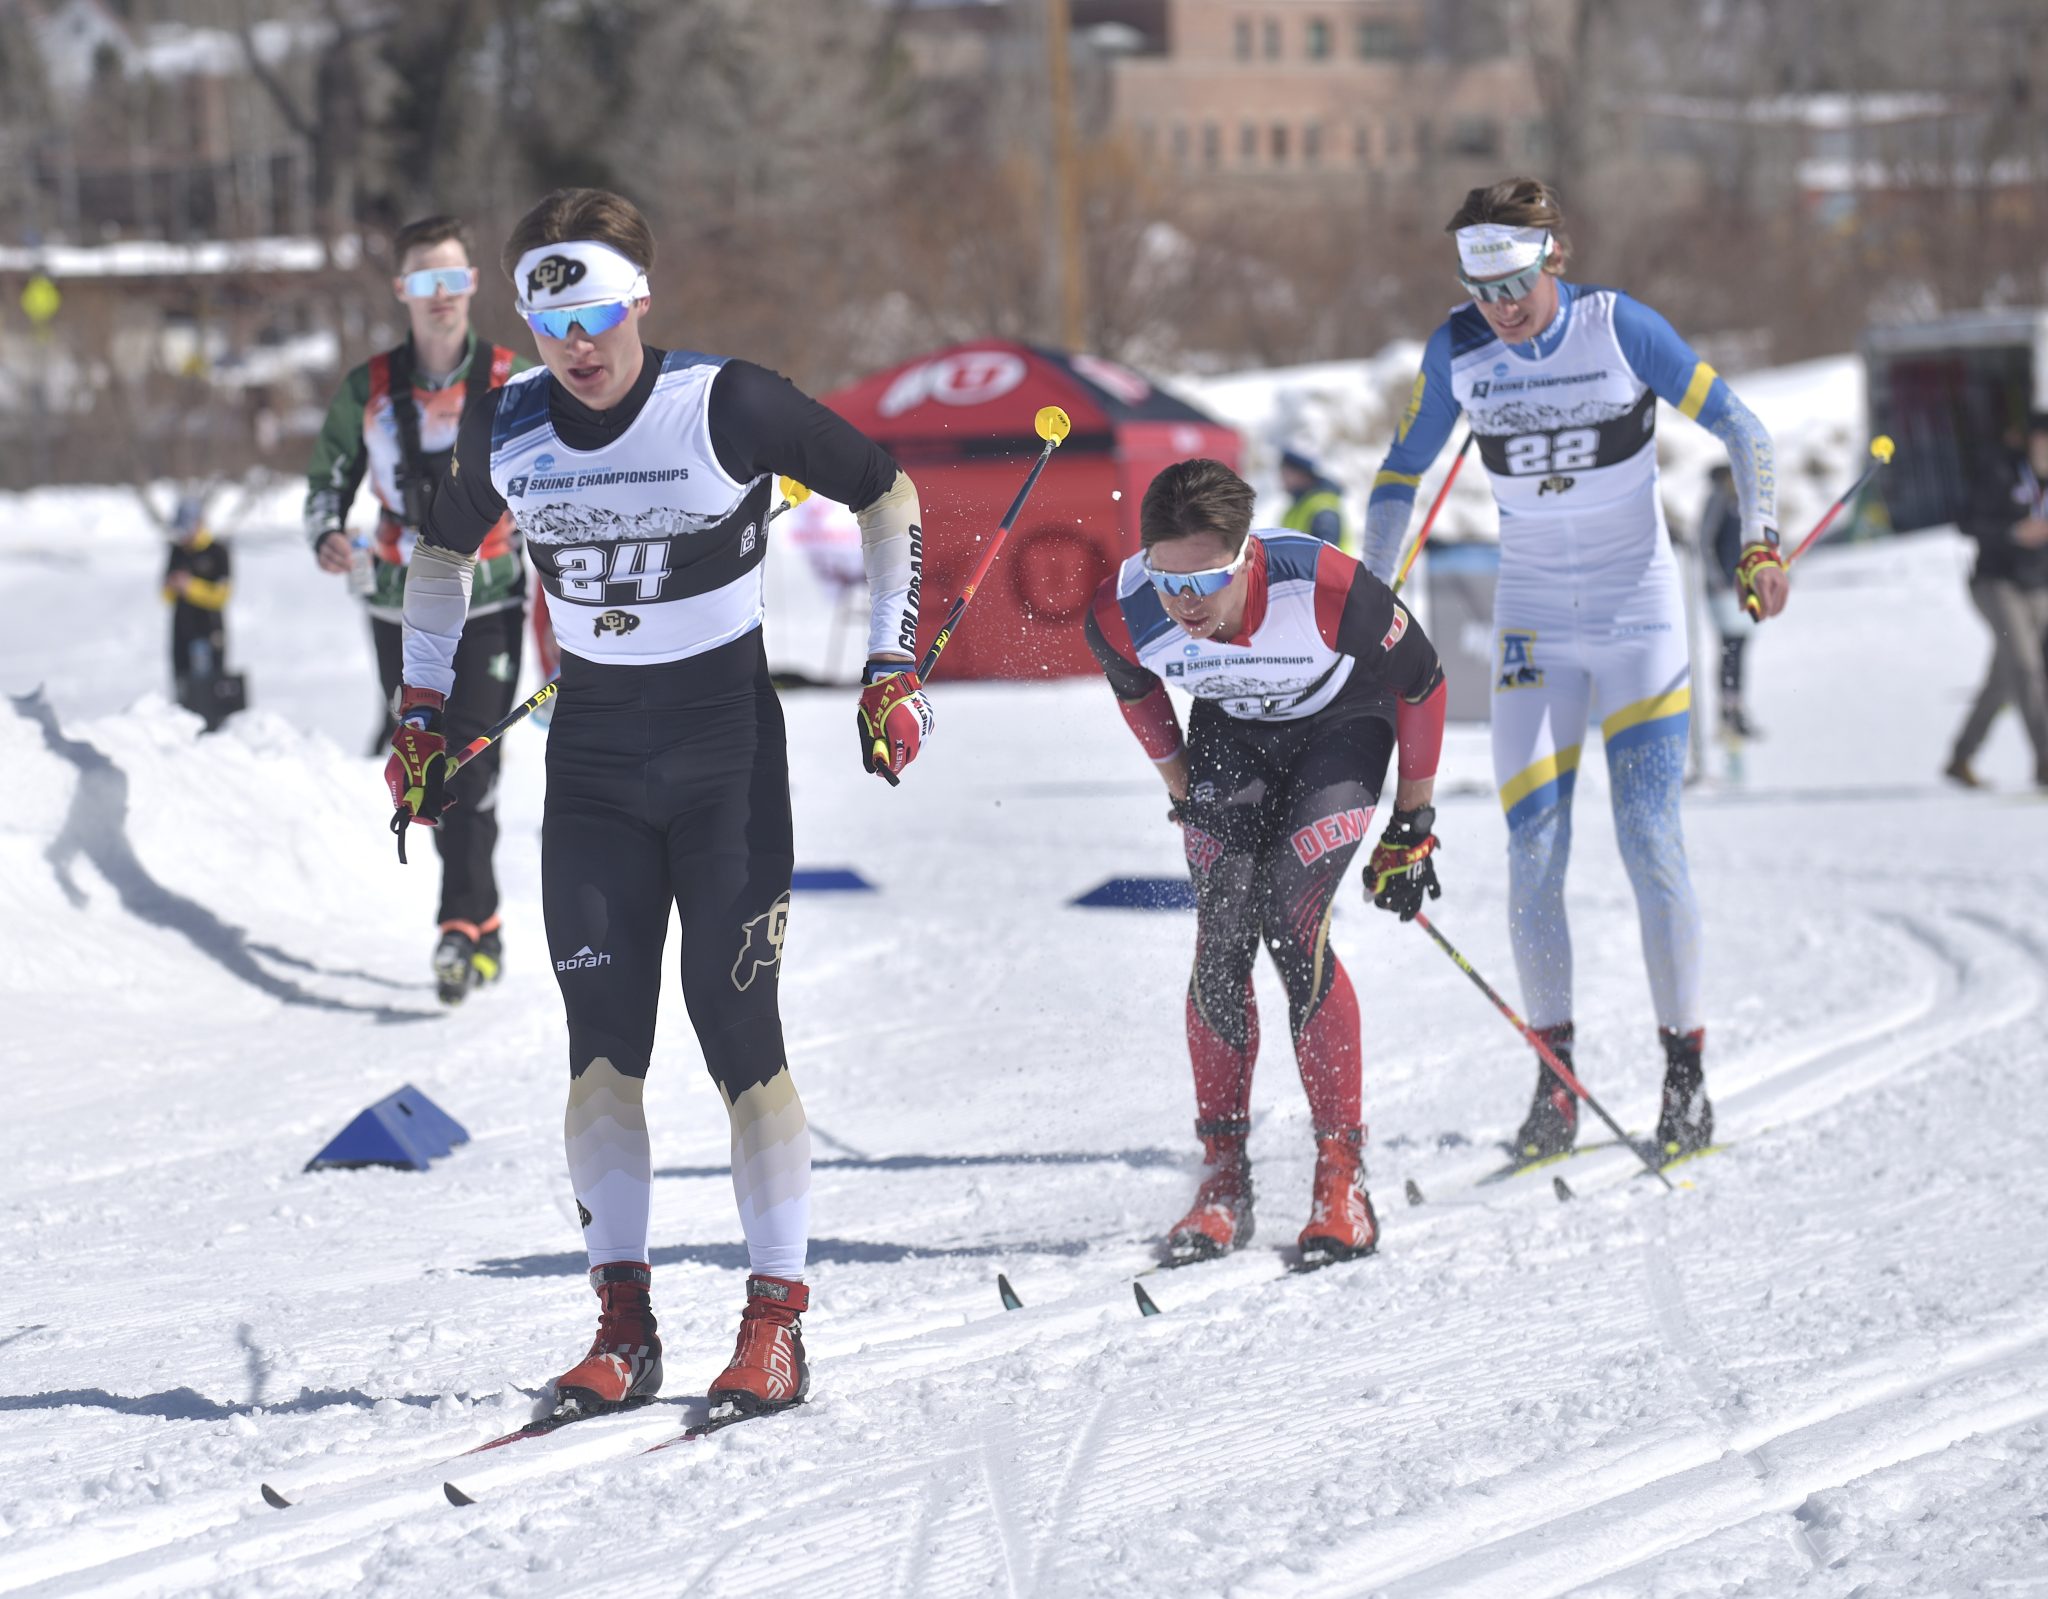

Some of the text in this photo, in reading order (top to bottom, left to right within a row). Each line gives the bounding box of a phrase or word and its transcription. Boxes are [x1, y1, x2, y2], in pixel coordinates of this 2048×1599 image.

[1527, 371, 1608, 391] CHAMPIONSHIPS
[1505, 427, 1600, 476] 22
[529, 468, 689, 491] SKIING CHAMPIONSHIPS
[553, 541, 673, 604] 24
[1224, 655, 1315, 666] CHAMPIONSHIPS
[872, 684, 895, 729] LEKI
[405, 735, 423, 777] LEKI
